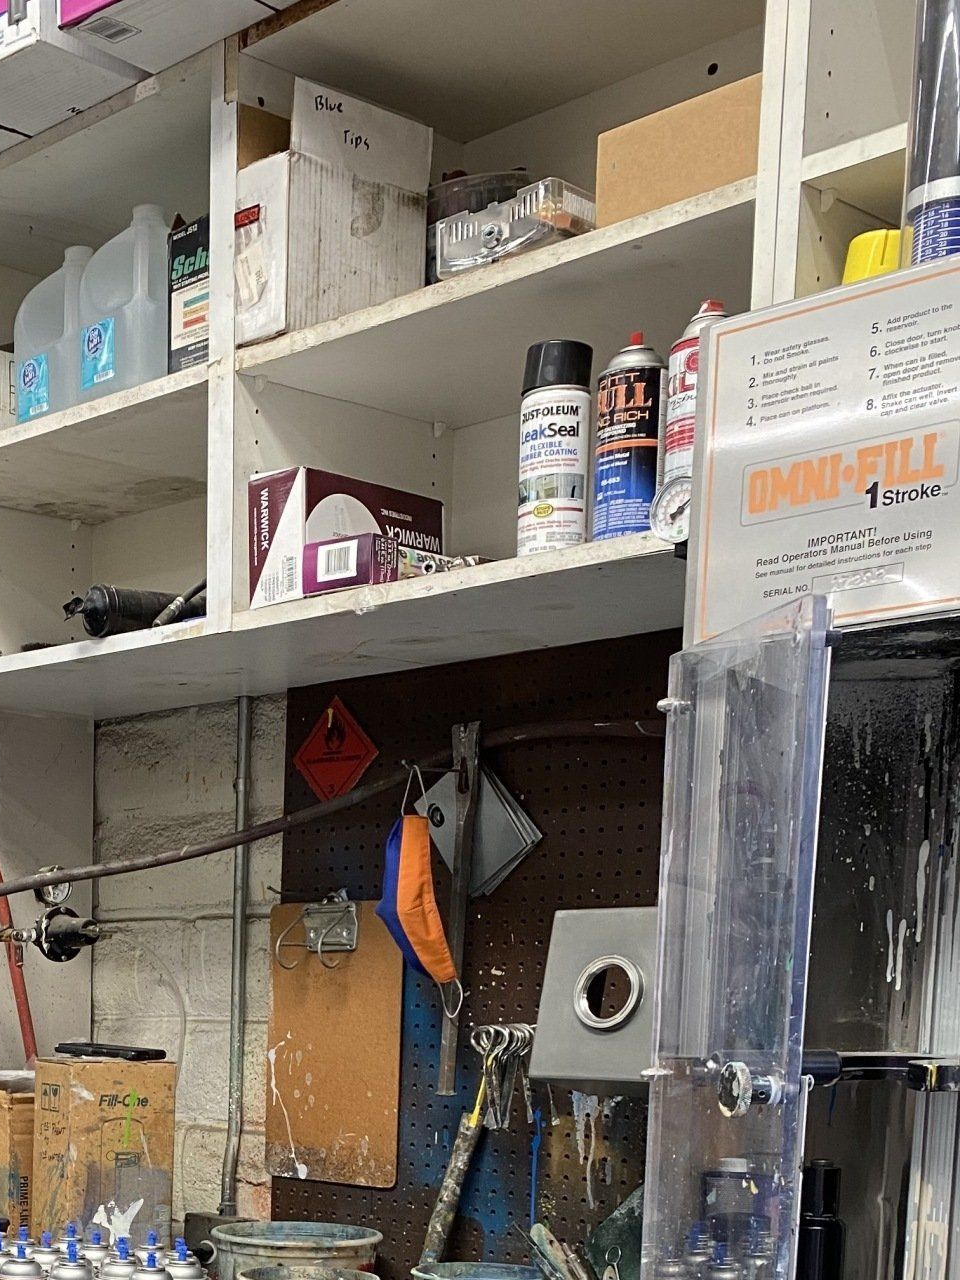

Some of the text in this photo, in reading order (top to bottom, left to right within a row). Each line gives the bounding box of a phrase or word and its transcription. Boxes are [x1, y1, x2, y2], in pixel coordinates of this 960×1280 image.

[315, 96, 343, 113] Blue
[344, 130, 370, 150] Tips
[171, 246, 209, 280] Sch
[887, 316, 900, 325] Add
[902, 308, 930, 323] product
[941, 303, 953, 312] the
[886, 321, 918, 333] reservoir.
[764, 336, 829, 357] Wear safety glasses.
[763, 371, 774, 379] Mix
[776, 368, 788, 377] and
[789, 364, 808, 374] strain
[818, 355, 839, 367] paints
[882, 356, 960, 380] open door and remove
[600, 372, 640, 389] PITT
[762, 374, 798, 387] thoroughly.
[761, 397, 790, 408] reservoir
[791, 392, 808, 401] when
[522, 405, 579, 424] RUST-OLEUM
[522, 421, 580, 444] LeakSeal
[530, 440, 562, 452] FLEXIBLE
[544, 448, 578, 457] COATING
[865, 481, 942, 509] 1 Stroke
[260, 488, 270, 550] WARWICK
[386, 524, 440, 552] WARWICK
[756, 529, 932, 567] Read Operators Manual Before Using
[808, 527, 877, 548] IMPORTANT!
[755, 543, 932, 579] See manual for detailed instructions for each step
[763, 584, 811, 598] SERIAL NO.
